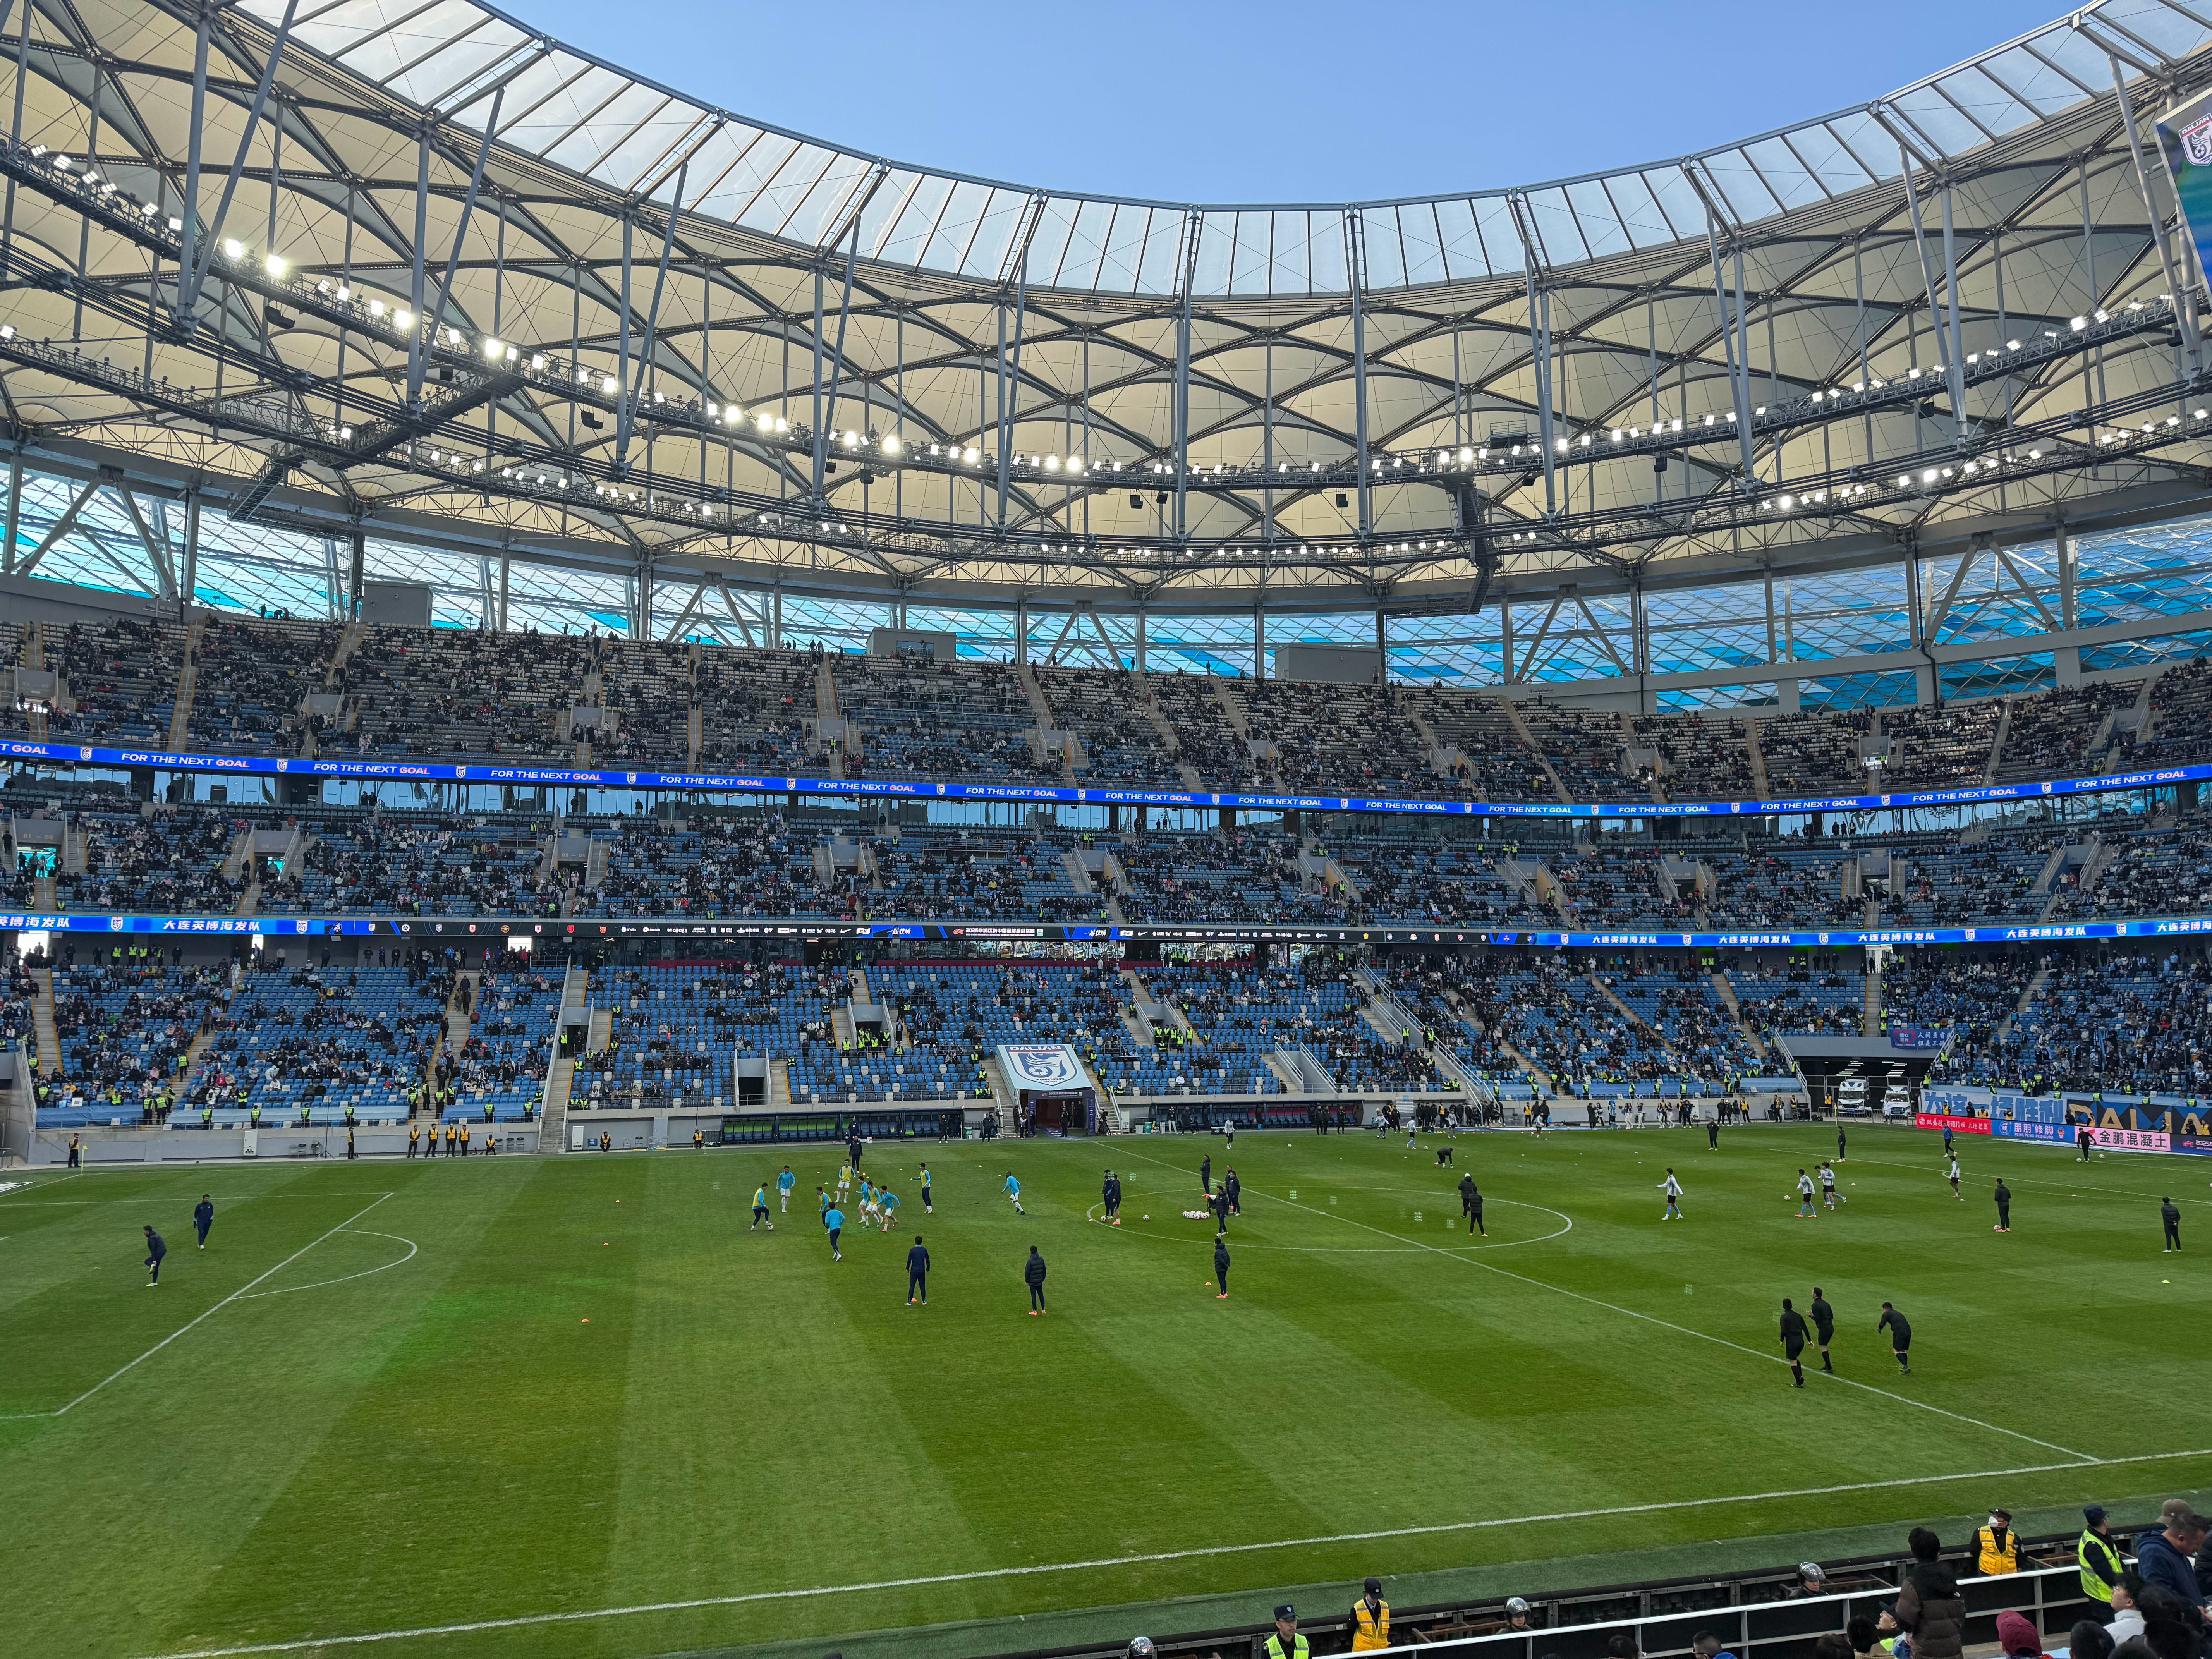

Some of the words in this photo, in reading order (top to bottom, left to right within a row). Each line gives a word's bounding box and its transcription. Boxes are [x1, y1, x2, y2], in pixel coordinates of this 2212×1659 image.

[2182, 116, 2209, 134] DALIAN
[12, 745, 49, 754] GOAL
[2124, 775, 2154, 783] NEXT
[2156, 771, 2187, 780] GOAL
[163, 918, 260, 931] 大连英博海发队
[2157, 921, 2212, 932] 大连英博海
[1859, 931, 1935, 942] 大连英博海发队
[2007, 925, 2086, 938] 大连英博海发队
[1719, 935, 1791, 944] 大连英博海发队
[1925, 1091, 2063, 1124] 为这一场胜利
[2099, 1130, 2167, 1148] 金鹏混凝土
